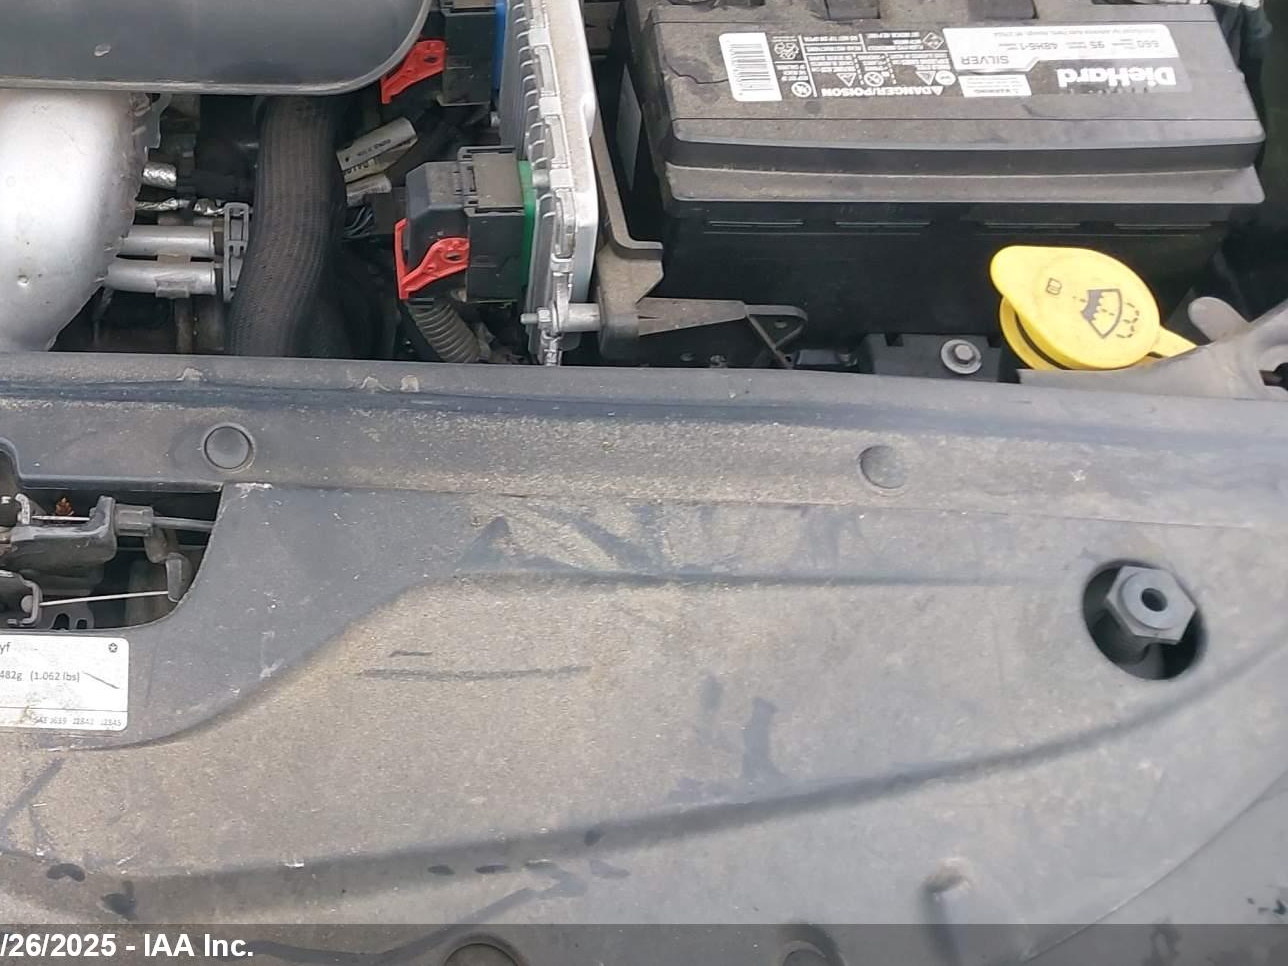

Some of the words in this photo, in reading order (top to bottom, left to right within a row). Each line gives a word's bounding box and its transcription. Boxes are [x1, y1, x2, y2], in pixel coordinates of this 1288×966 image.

[960, 55, 1009, 65] SILVER
[1056, 66, 1177, 88] DieHard
[0, 670, 23, 682] 482g
[62, 670, 81, 683] lbs)
